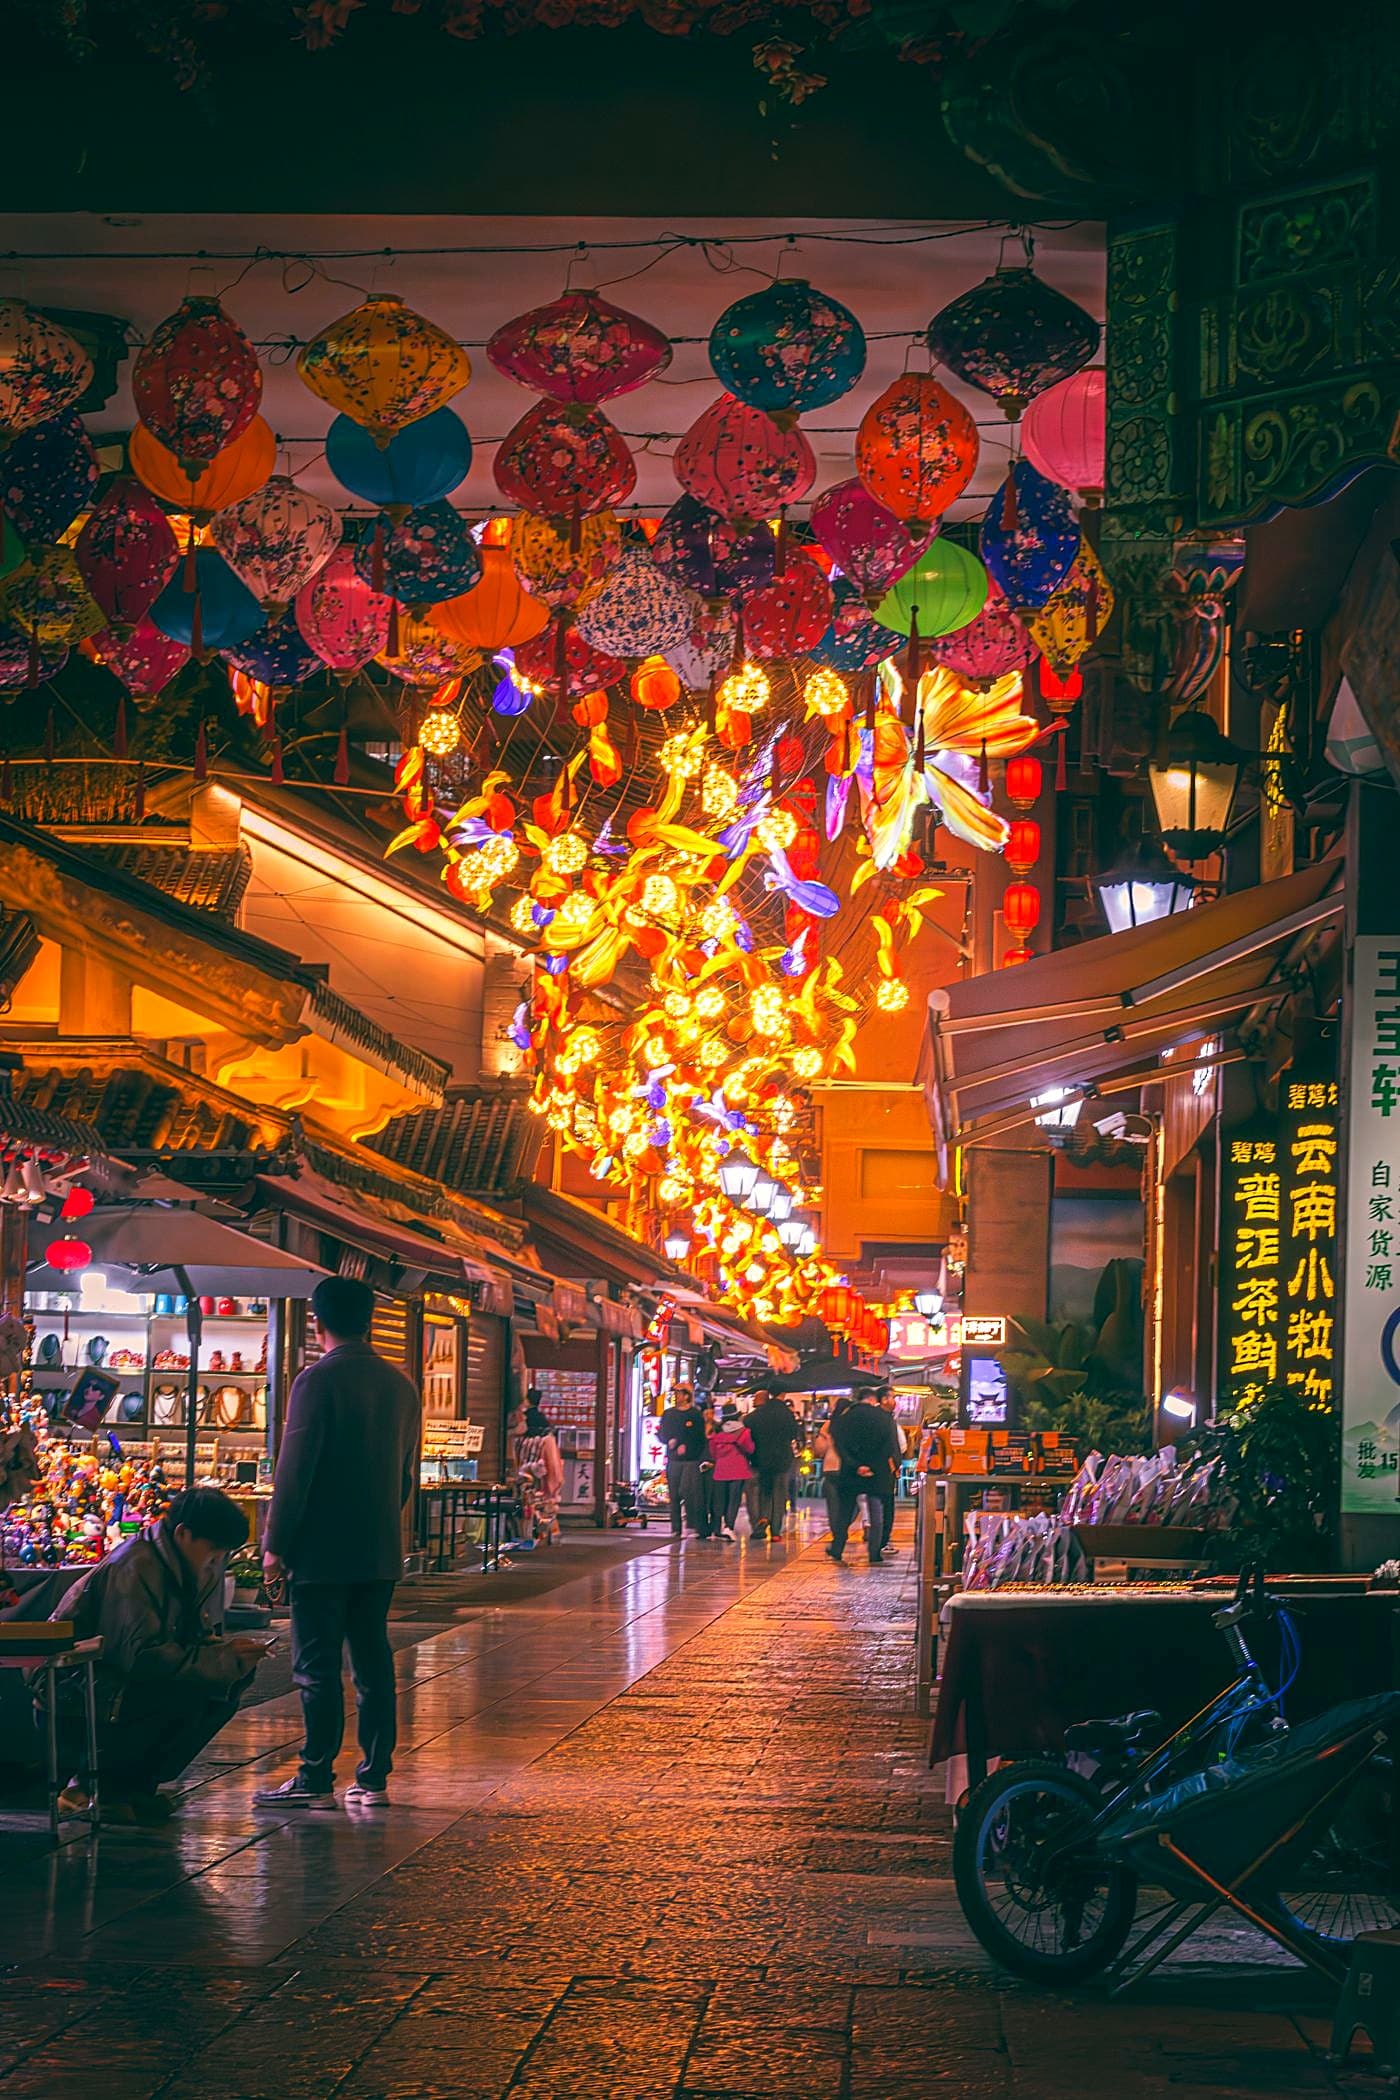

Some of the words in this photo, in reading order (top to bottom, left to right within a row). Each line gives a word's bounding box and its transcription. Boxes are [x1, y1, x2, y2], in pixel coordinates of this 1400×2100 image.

[1366, 1160, 1394, 1291] 自家货源
[1358, 1441, 1376, 1479] 批发
